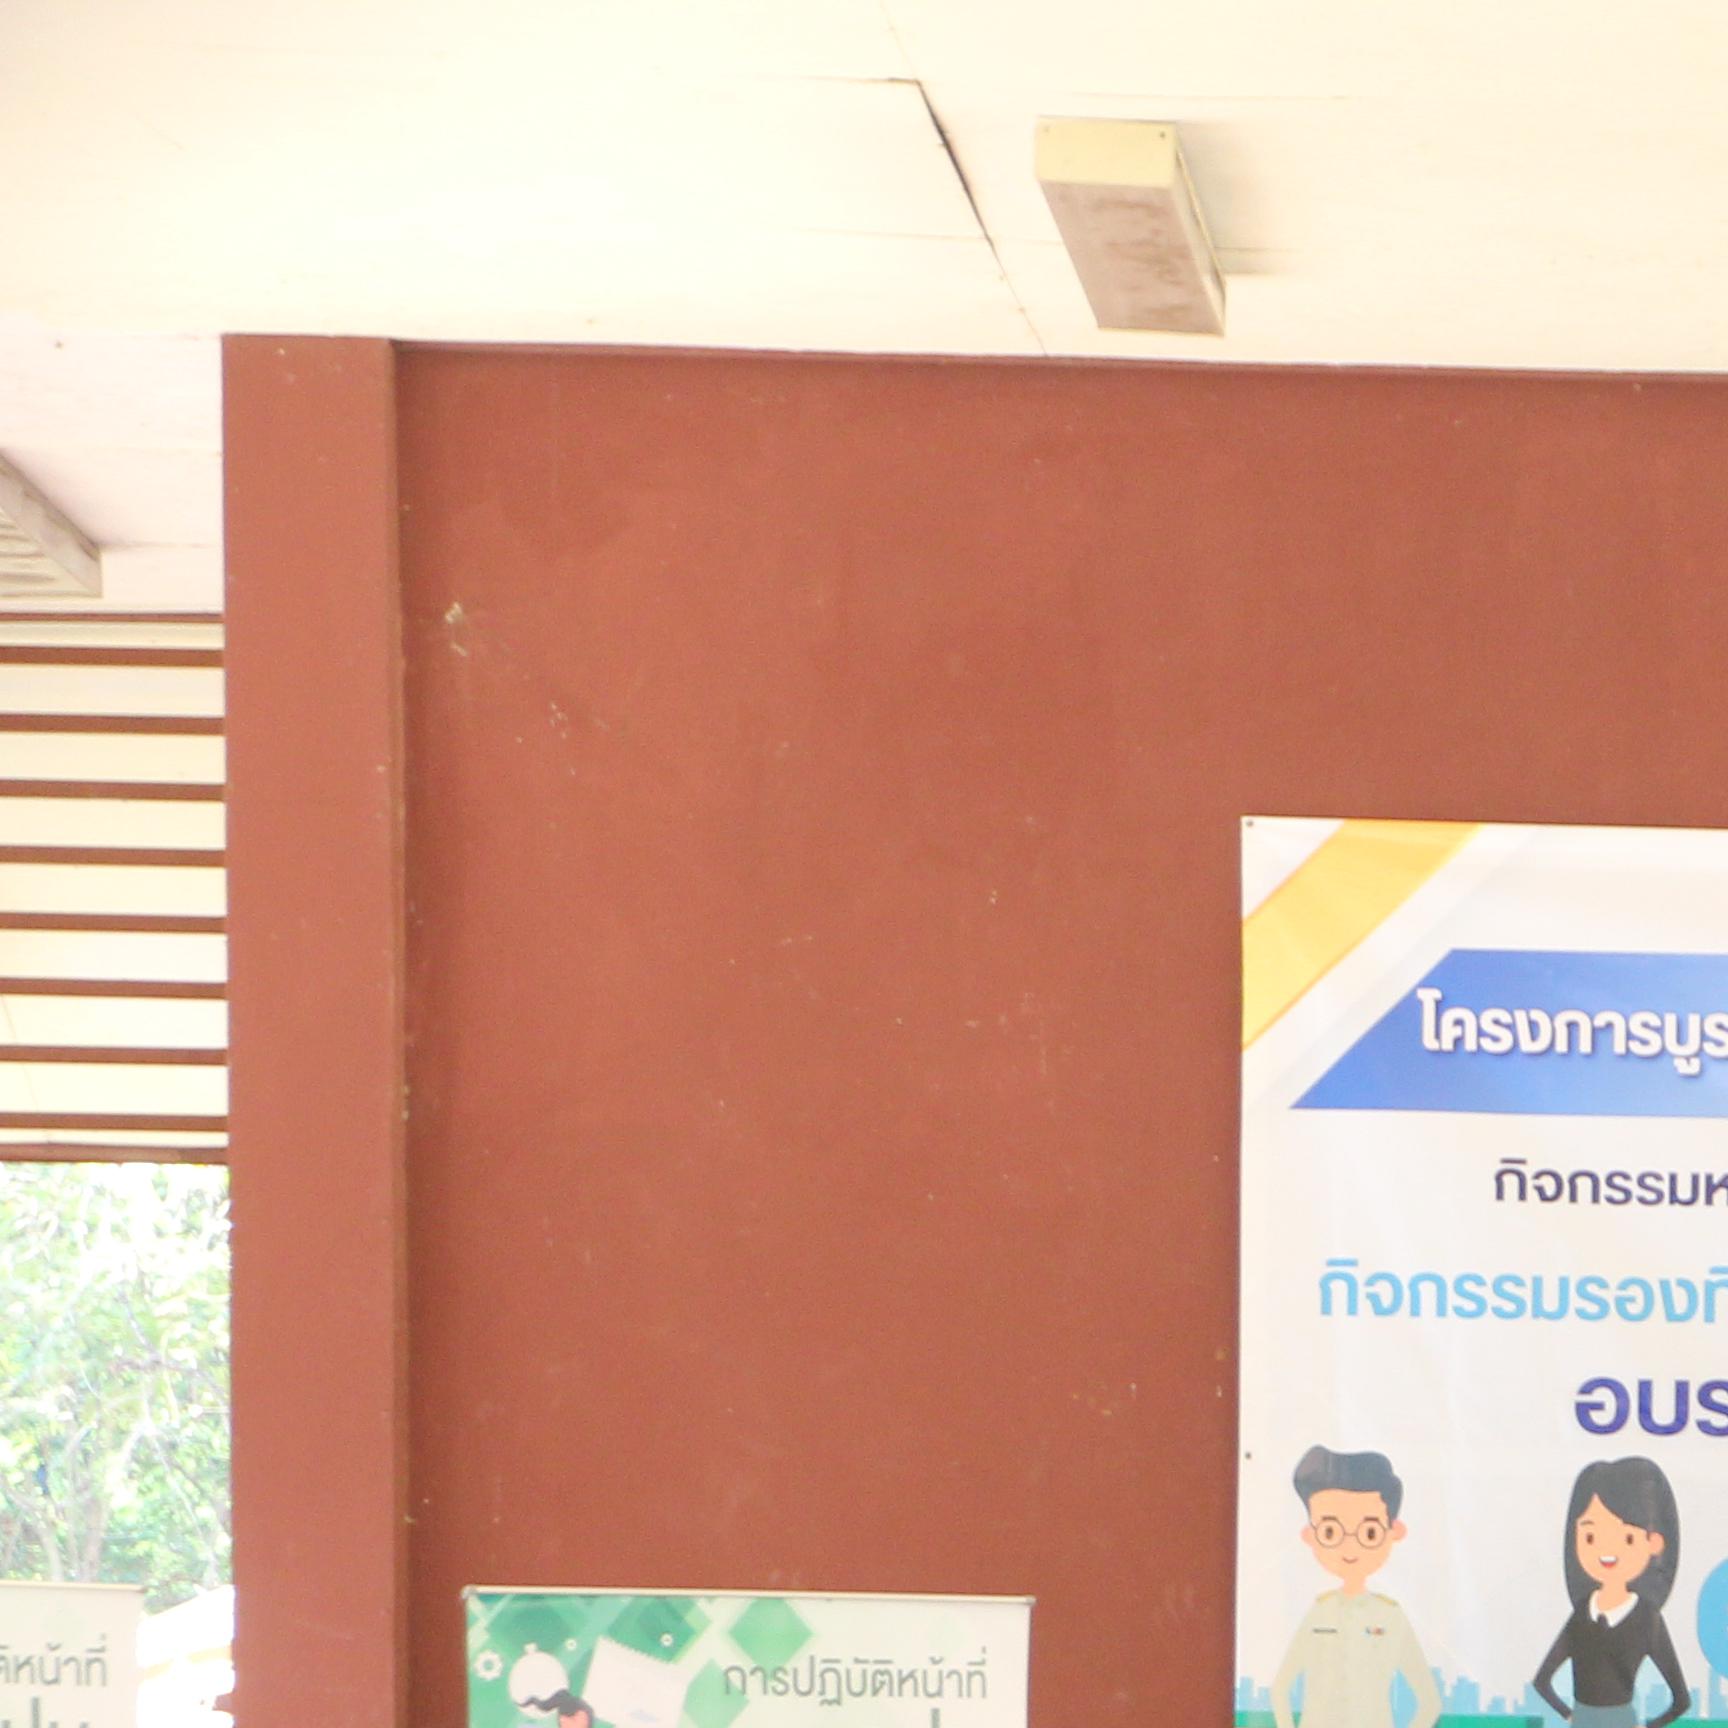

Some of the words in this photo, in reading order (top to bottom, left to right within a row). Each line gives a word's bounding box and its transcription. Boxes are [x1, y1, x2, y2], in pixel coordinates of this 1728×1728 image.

[723, 1646, 987, 1706] การปฏิบัติหน้าที่
